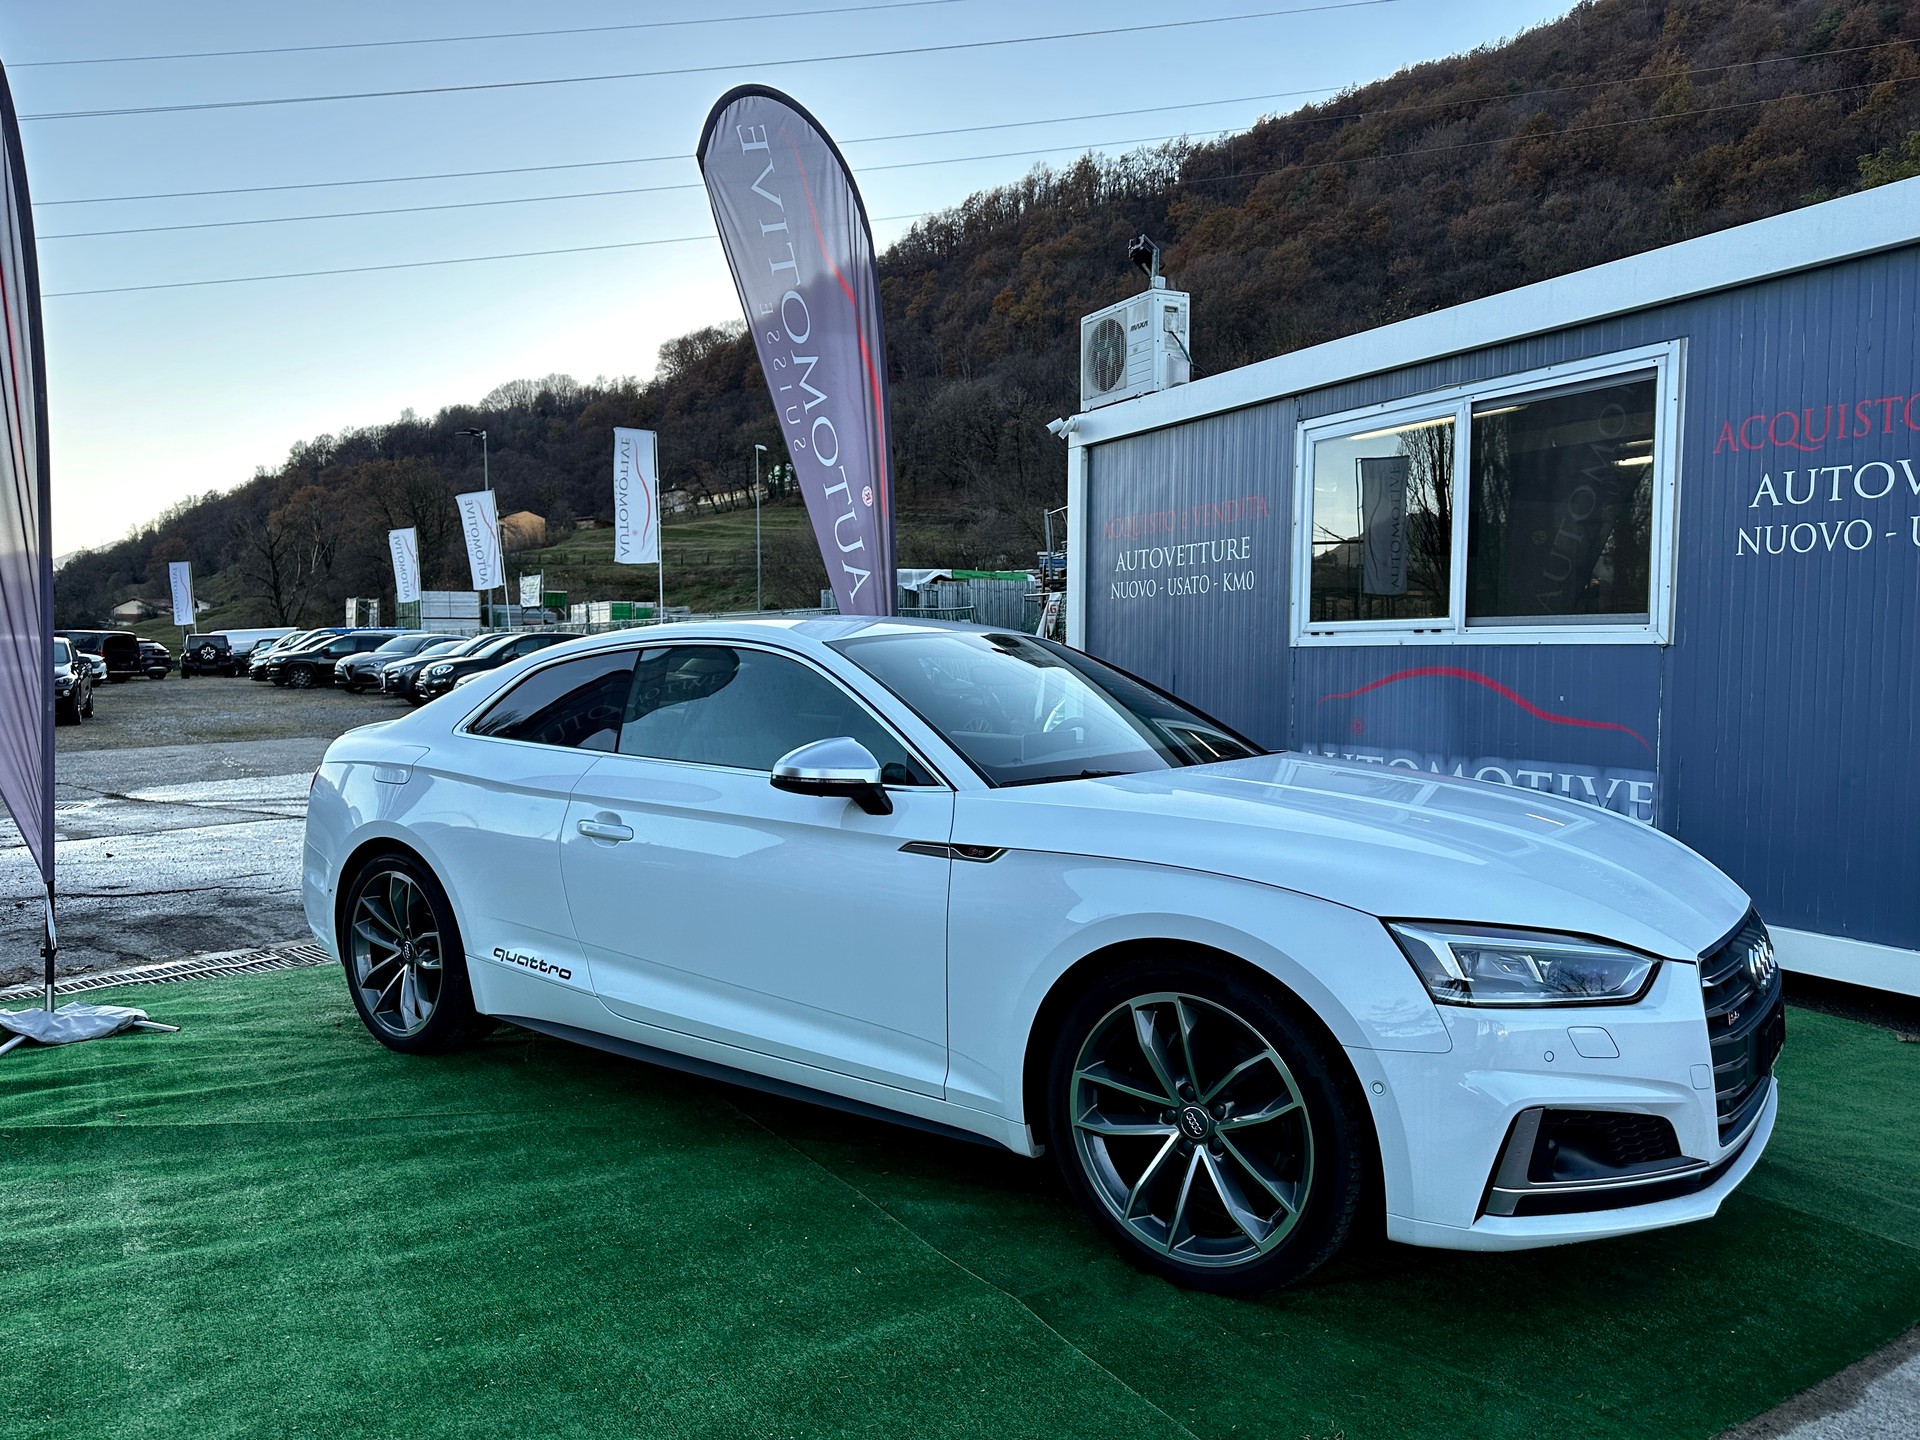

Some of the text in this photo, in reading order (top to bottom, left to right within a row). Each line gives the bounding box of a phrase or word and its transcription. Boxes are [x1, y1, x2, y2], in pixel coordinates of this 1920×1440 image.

[1103, 511, 1176, 541] ACQUISTO
[1192, 495, 1270, 530] VENDITA
[1115, 536, 1251, 572] AUTOVETTURE
[1735, 519, 1873, 556] NUOVO
[1110, 579, 1157, 599] NUOVO
[1167, 574, 1210, 596] USATO
[493, 946, 572, 981] quattro
